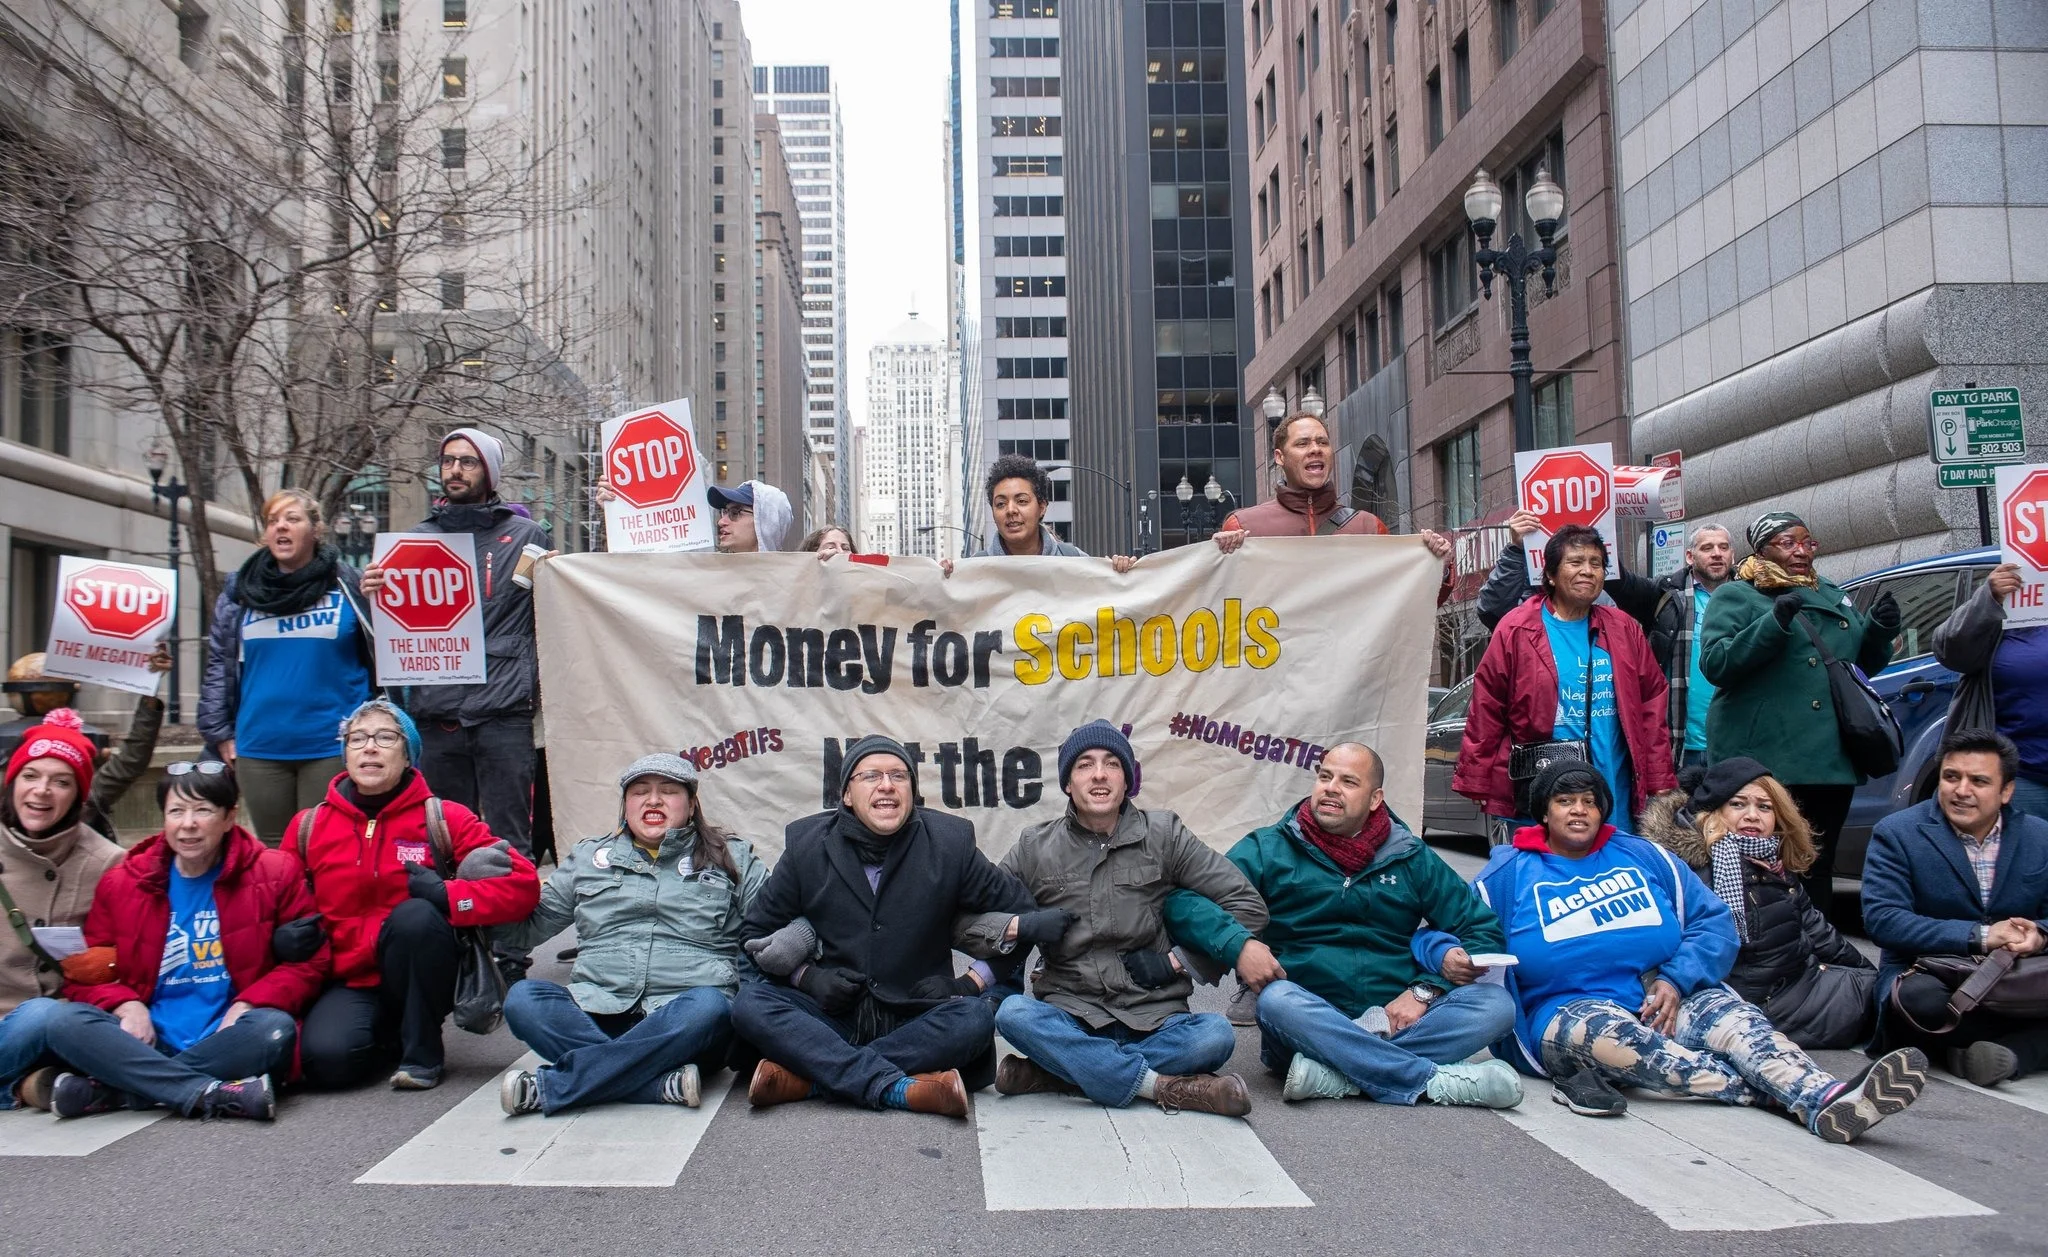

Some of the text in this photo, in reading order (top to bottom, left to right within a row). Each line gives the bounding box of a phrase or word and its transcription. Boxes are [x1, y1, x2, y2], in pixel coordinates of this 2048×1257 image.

[1938, 391, 2013, 404] PAY TO PARK
[1981, 444, 2000, 453] 802
[2002, 443, 2020, 452] 903
[612, 435, 684, 487] STOP
[1942, 470, 1948, 480] 7
[1950, 470, 1965, 480] DAY
[1968, 469, 1987, 479] PAID
[1531, 475, 1602, 516] STOP
[620, 505, 696, 530] THE LINCOLN
[630, 524, 689, 546] YARDS TIF
[74, 577, 161, 616] STOP
[383, 567, 464, 607] STOP
[2011, 583, 2046, 609] THE
[278, 611, 334, 634] NOW
[54, 639, 84, 659] THE
[388, 637, 470, 654] THE LINCOLN
[695, 598, 1282, 694] Money for Schools
[399, 655, 462, 671] YARDS TIF
[1577, 656, 1609, 668] Lgan
[1577, 672, 1613, 684] Suare
[934, 737, 1043, 809] the
[397, 852, 425, 861] UNION
[1547, 872, 1637, 920] Action
[1590, 891, 1651, 927] NOW
